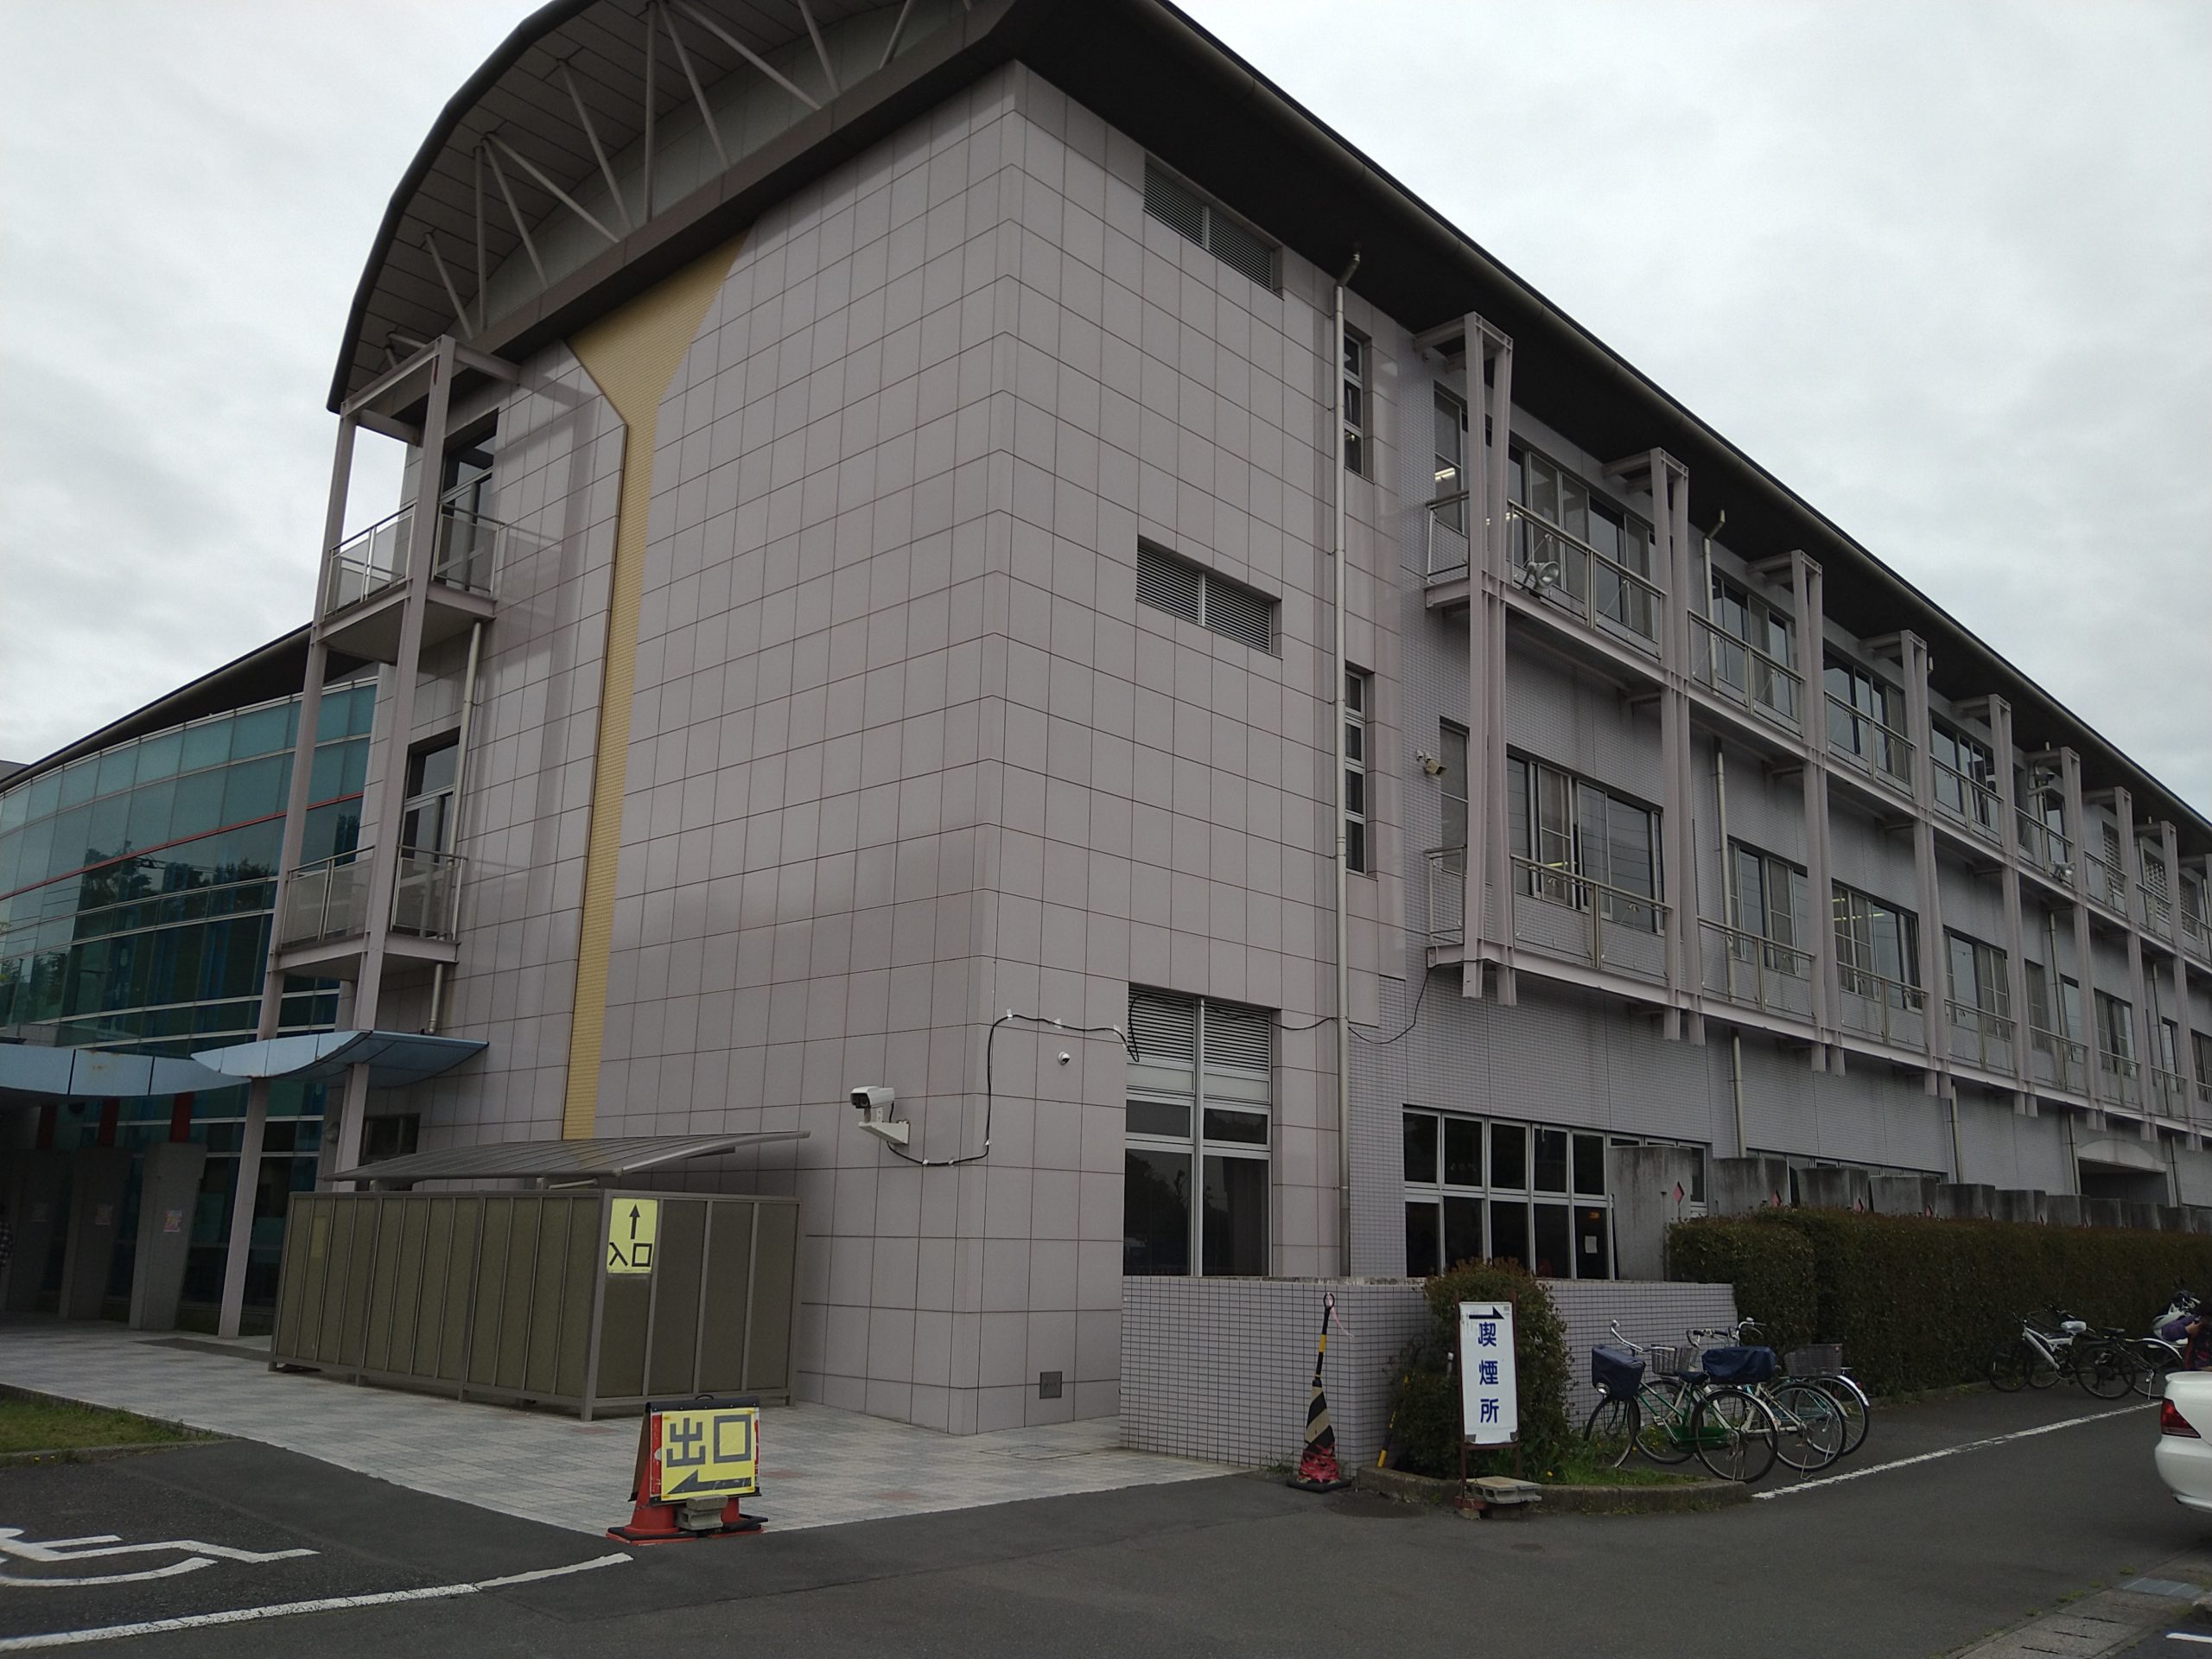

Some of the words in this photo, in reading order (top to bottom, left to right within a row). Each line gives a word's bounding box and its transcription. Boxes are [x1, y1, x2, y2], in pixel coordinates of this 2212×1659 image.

[609, 1242, 652, 1267] 入口
[1478, 1321, 1499, 1424] 喫煙所
[666, 1414, 752, 1468] 出口
